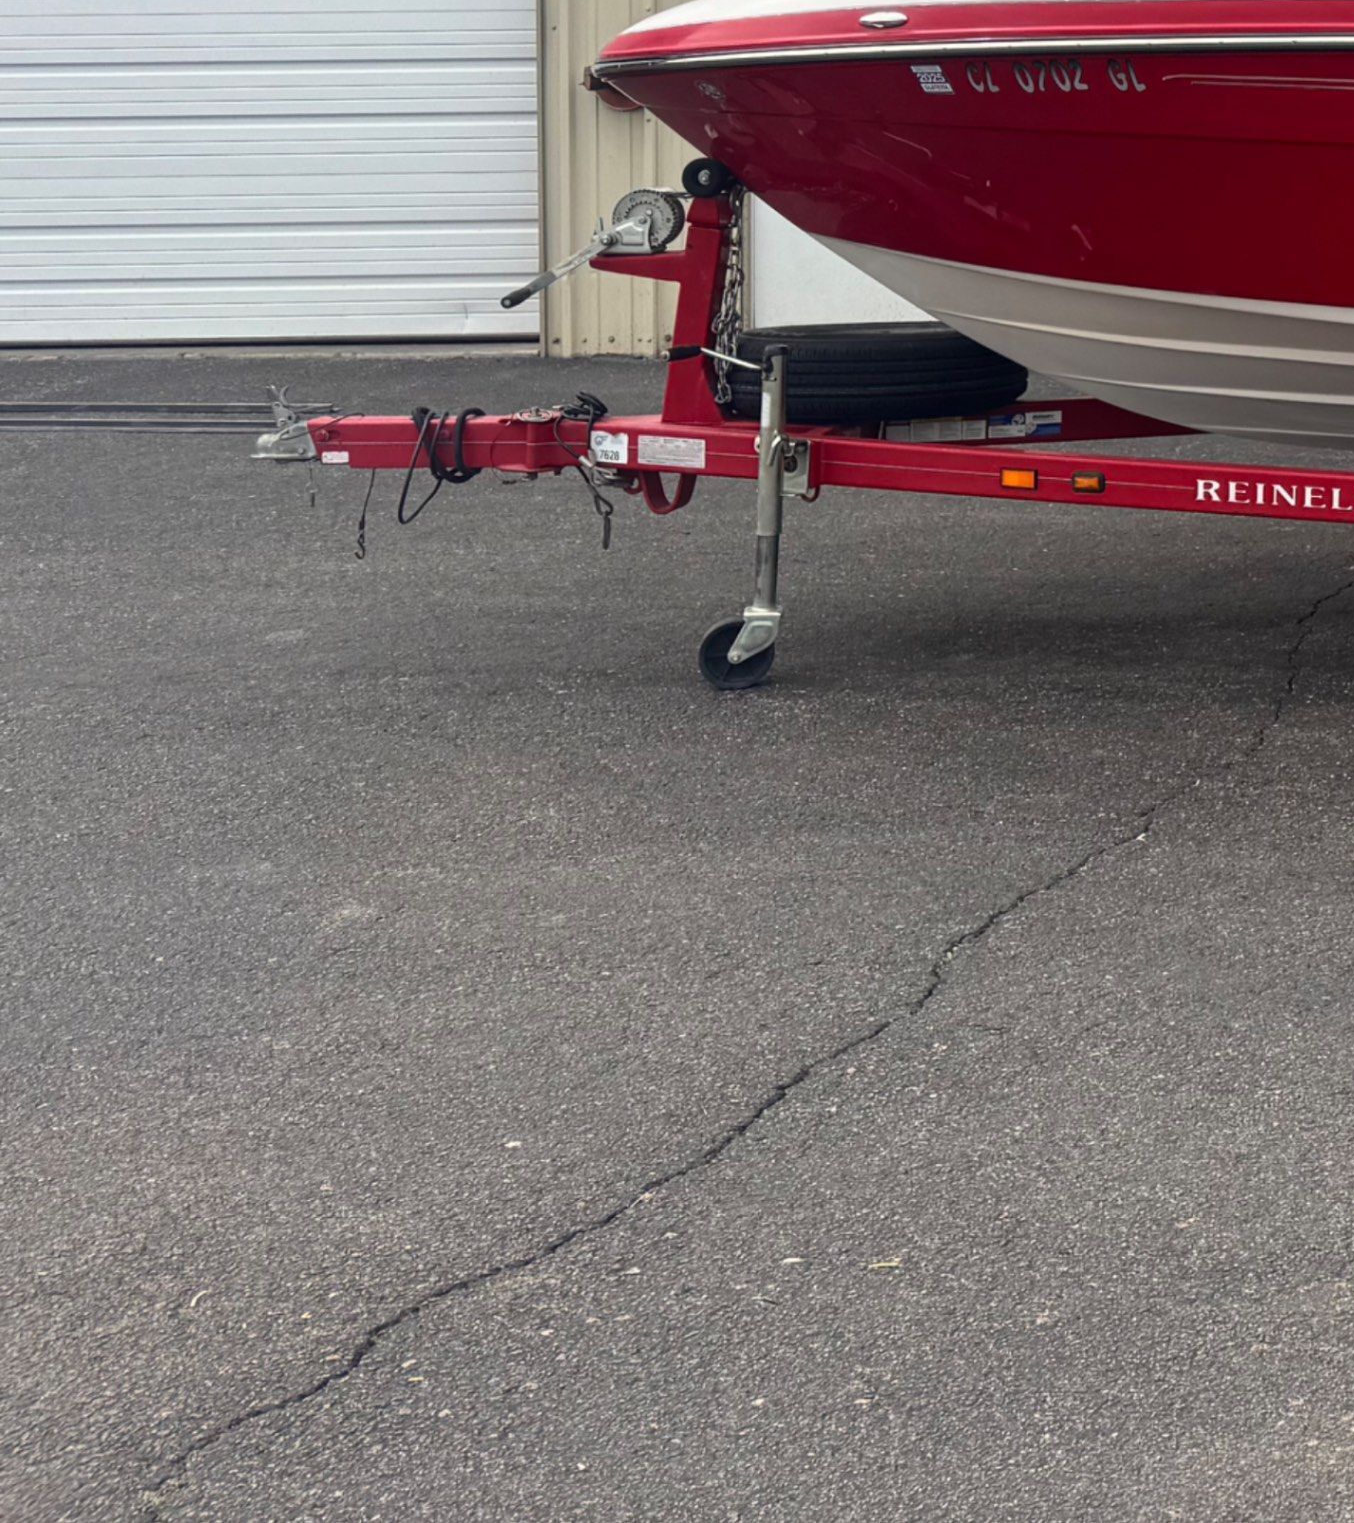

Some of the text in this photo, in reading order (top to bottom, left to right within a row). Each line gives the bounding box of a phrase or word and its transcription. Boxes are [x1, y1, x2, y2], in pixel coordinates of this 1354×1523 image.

[965, 58, 1147, 93] CL 0702 GL
